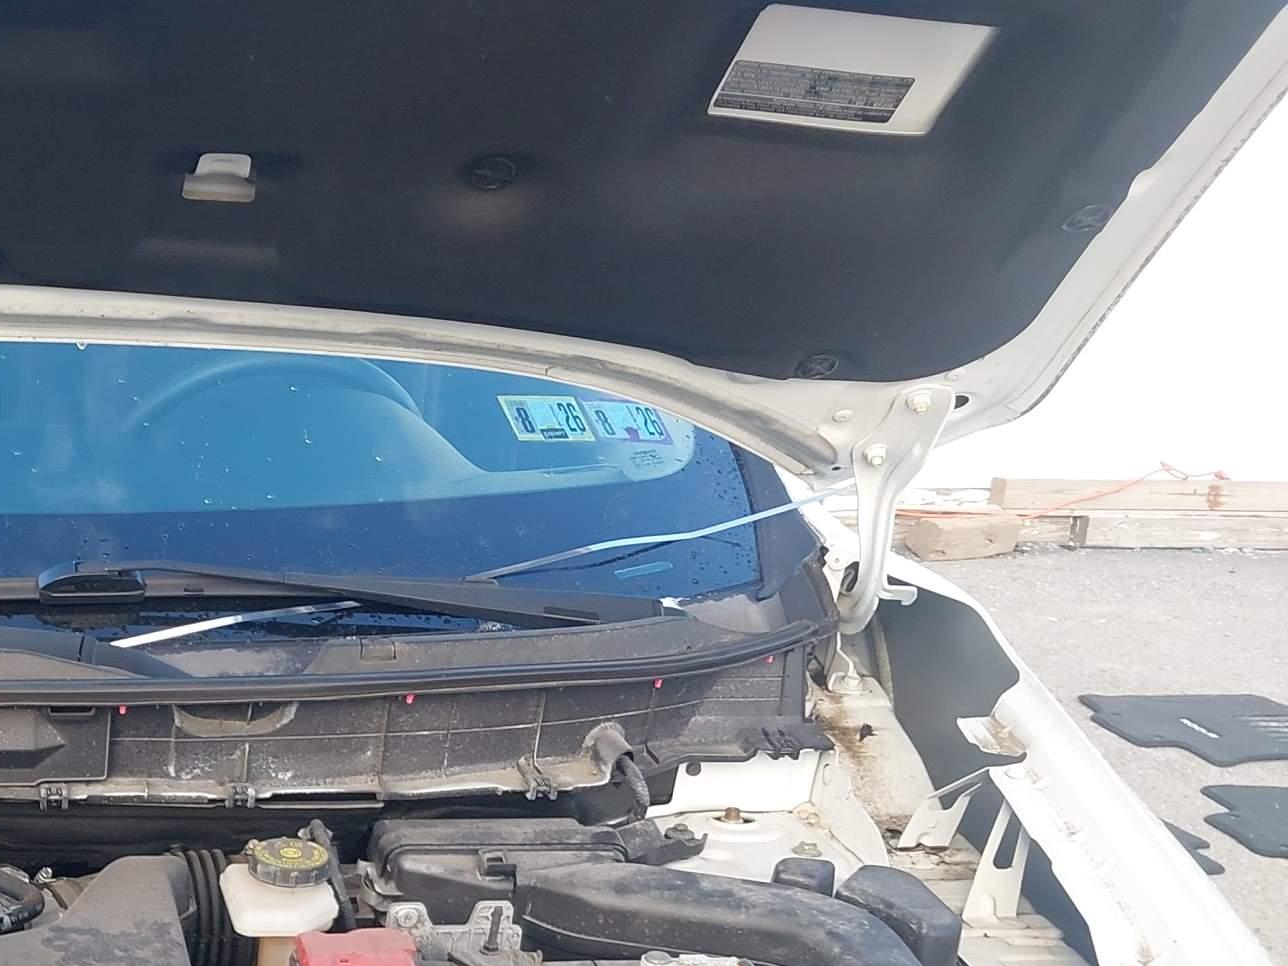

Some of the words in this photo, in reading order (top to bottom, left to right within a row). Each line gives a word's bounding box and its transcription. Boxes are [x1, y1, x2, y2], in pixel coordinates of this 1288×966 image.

[515, 407, 536, 434] 8
[556, 403, 587, 433] 26
[595, 410, 617, 436] 8
[636, 407, 666, 437] 26
